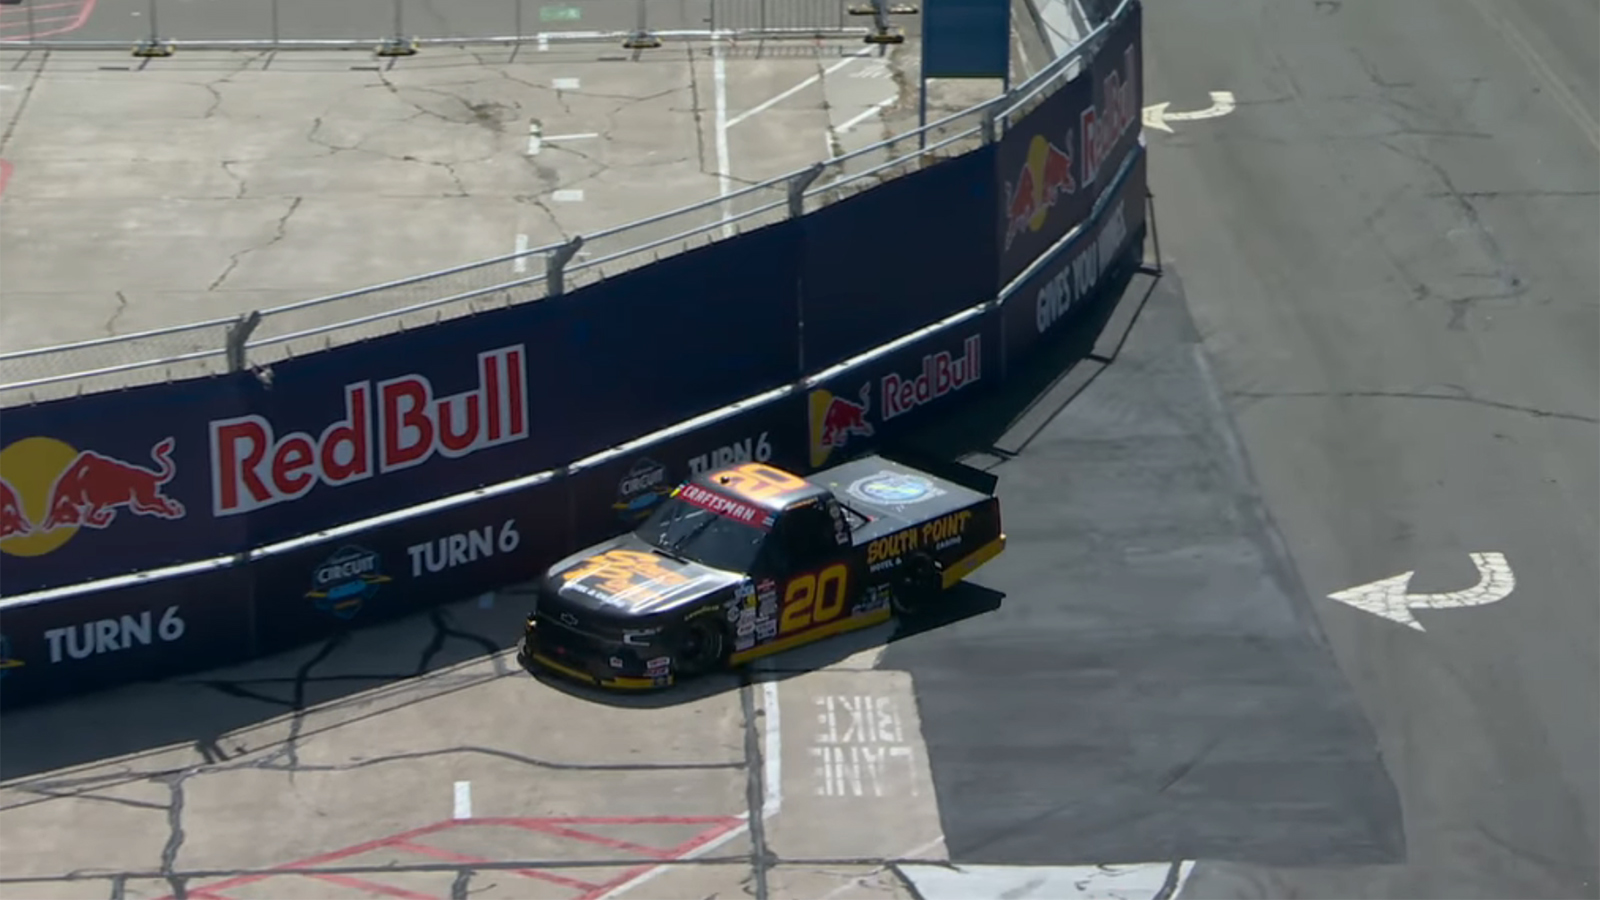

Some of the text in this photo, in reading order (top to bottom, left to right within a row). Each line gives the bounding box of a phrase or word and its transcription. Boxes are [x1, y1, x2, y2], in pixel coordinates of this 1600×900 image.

[1036, 241, 1097, 333] GIVES YOU
[755, 432, 772, 462] 6
[621, 467, 666, 495] CIRCUIT
[683, 484, 756, 522] CRAFTSMAN
[407, 519, 520, 577] TURN 6
[867, 510, 971, 564] SOUTH POINT
[317, 555, 375, 584] CIRCUIT
[779, 564, 847, 633] 20
[44, 606, 185, 662] TURN 6
[815, 695, 903, 743] BIKE
[811, 747, 919, 796] LANE
